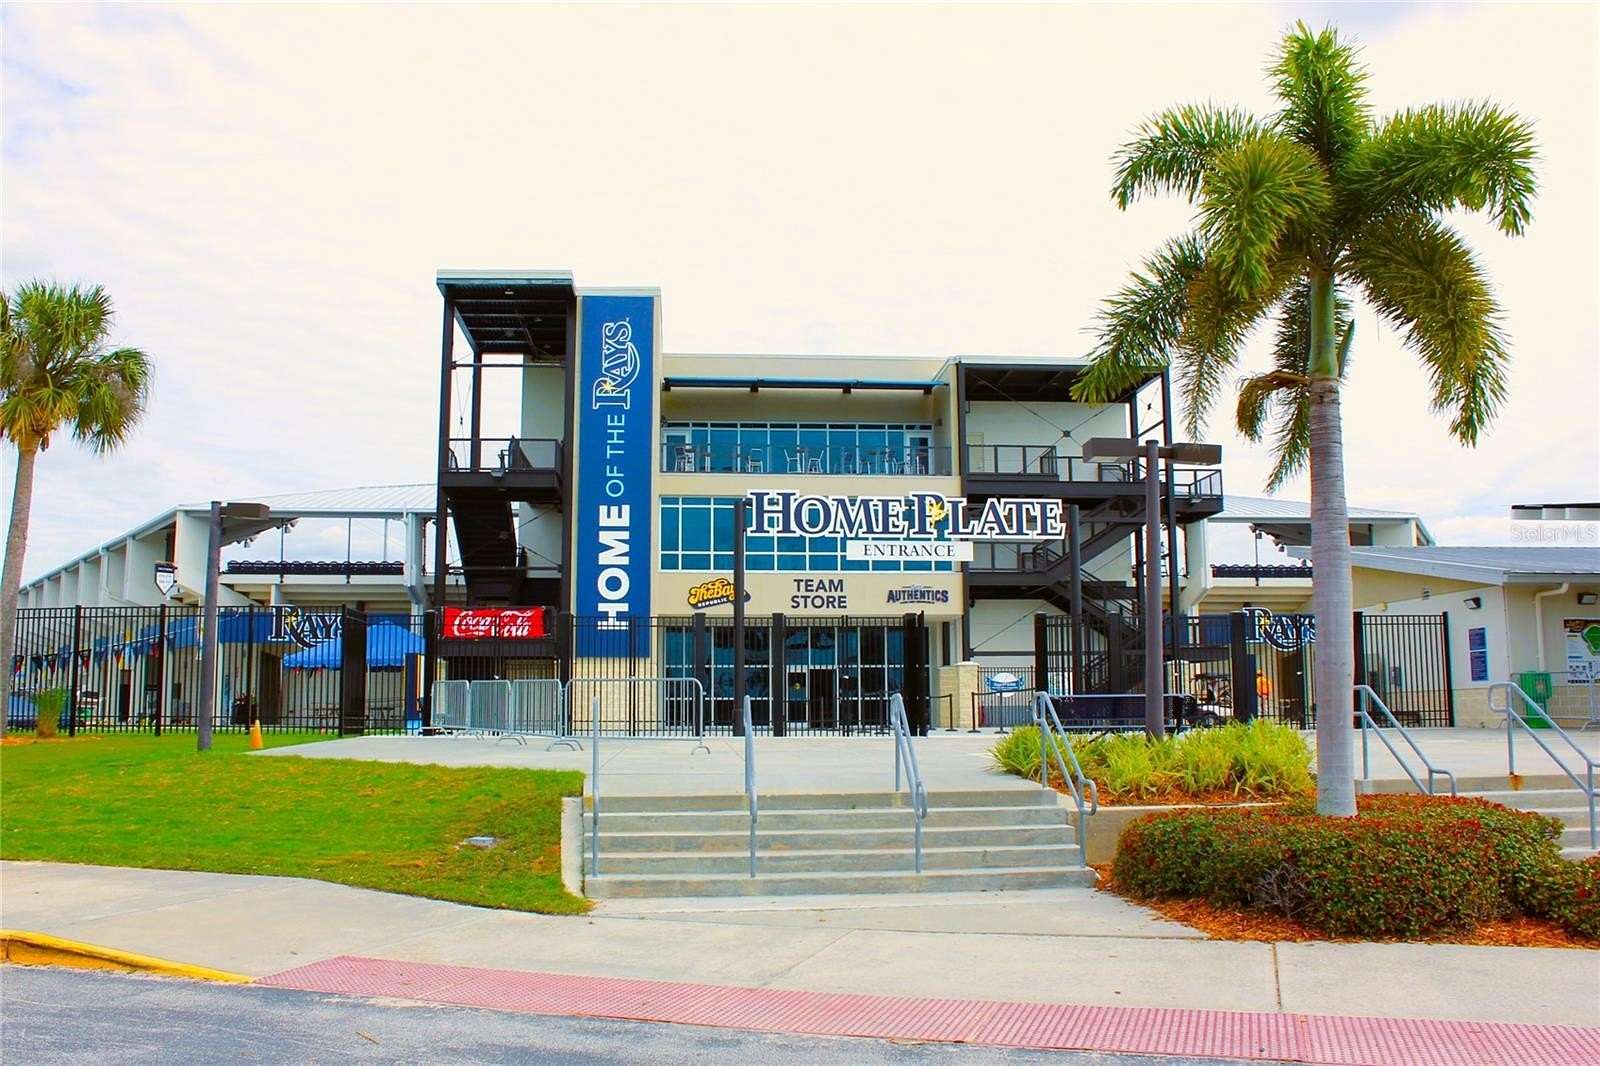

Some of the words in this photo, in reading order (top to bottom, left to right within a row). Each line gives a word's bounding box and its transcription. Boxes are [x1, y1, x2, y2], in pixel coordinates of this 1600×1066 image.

[592, 320, 640, 410] RAYS
[606, 414, 625, 459] THE
[606, 465, 625, 498] OF
[746, 489, 906, 537] HOME
[905, 489, 1067, 540] PLATE
[597, 504, 630, 630] HOME
[863, 544, 956, 559] ENTRANCE
[791, 595, 848, 609] STORE
[793, 578, 844, 593] TEAM
[887, 588, 950, 603] AUTHENTICS
